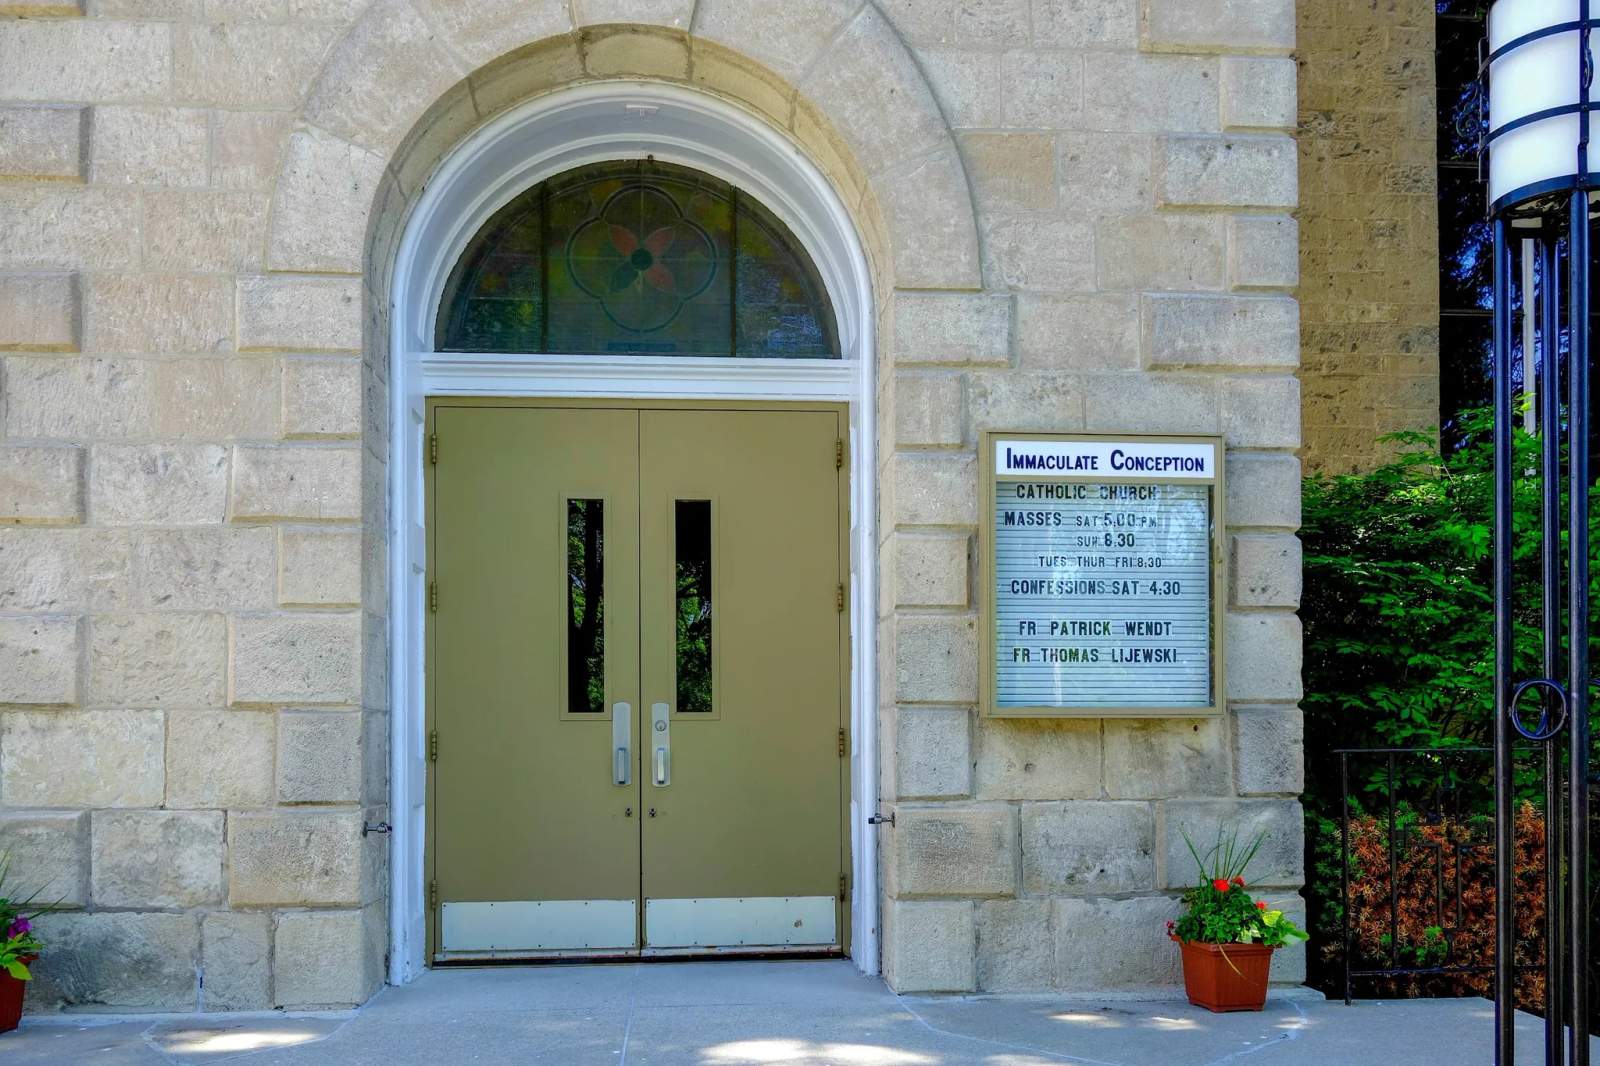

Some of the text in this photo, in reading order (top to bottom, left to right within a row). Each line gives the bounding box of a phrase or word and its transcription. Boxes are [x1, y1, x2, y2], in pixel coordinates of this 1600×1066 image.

[1016, 485, 1157, 501] CATHOLIC CHURCH
[1004, 512, 1062, 526] MASSES
[1076, 516, 1097, 527] SAT
[1077, 536, 1098, 547] SUN
[1039, 556, 1067, 567] TUES
[1077, 556, 1105, 567] THUR
[1115, 557, 1133, 567] FRI
[1011, 580, 1181, 595] CONFESSIONS SAT 4:30
[1019, 621, 1172, 636] FR PATRICK WENDT
[1013, 648, 1177, 663] FR THOMAS LIJEWSKI
